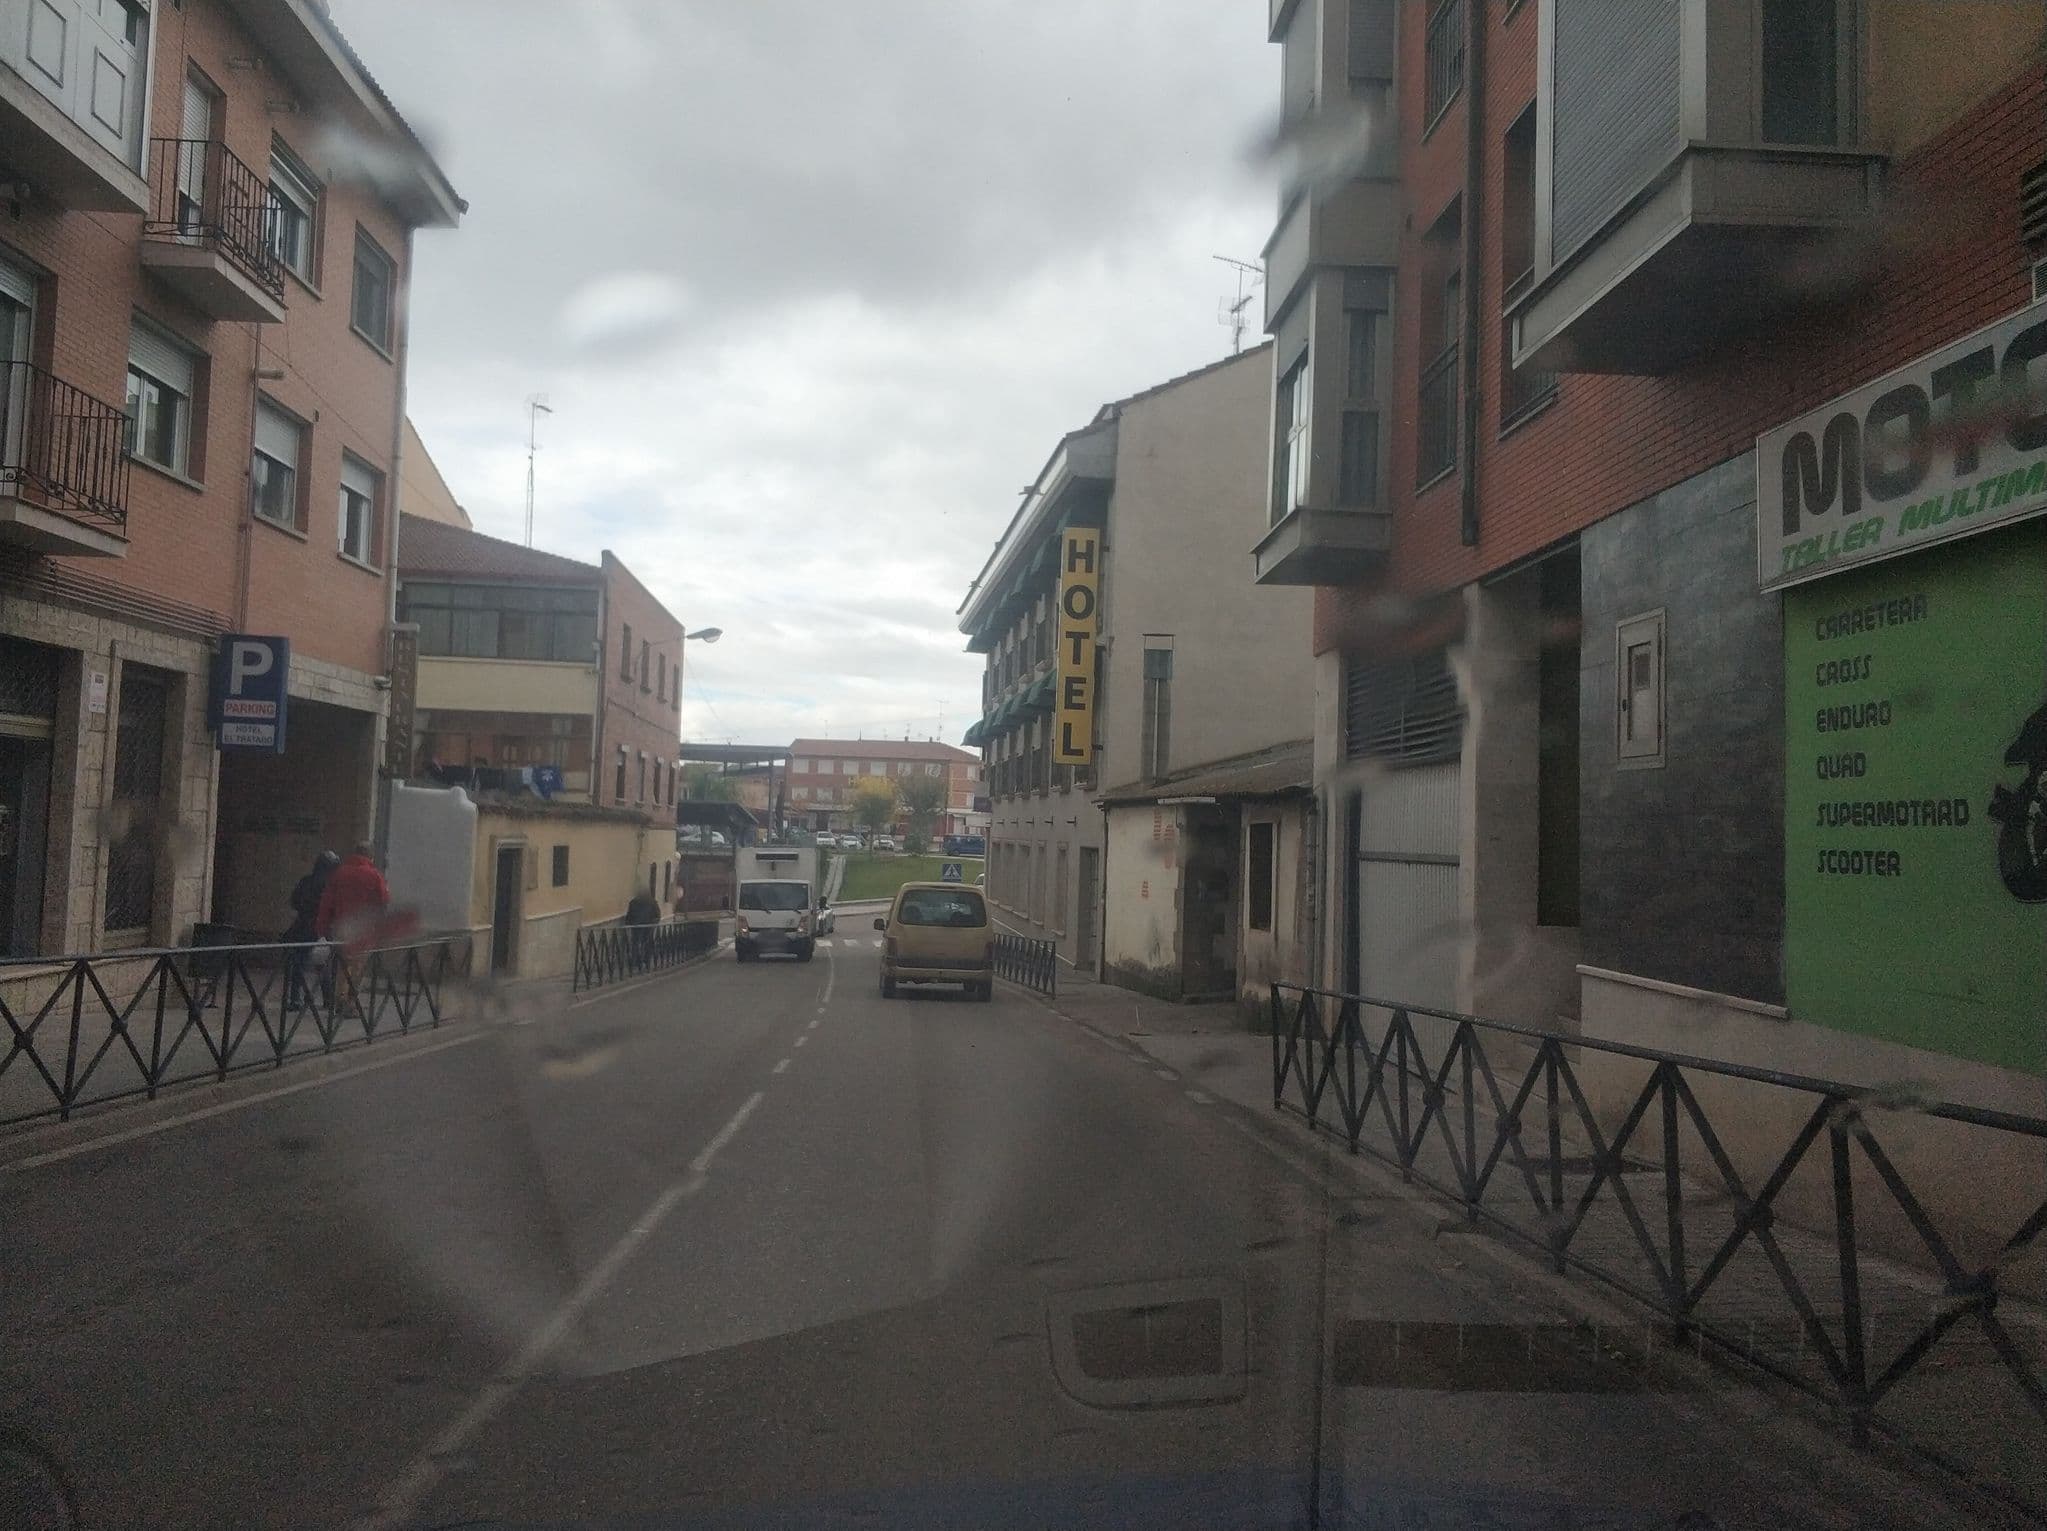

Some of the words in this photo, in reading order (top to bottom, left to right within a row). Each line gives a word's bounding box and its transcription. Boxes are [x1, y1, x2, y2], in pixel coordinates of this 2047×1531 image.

[1782, 516, 1885, 573] TALLER
[1815, 592, 1929, 641] CARRETERA
[1062, 539, 1095, 757] HOTEL
[230, 641, 274, 695] P
[1815, 654, 1872, 687] CROSS
[225, 702, 274, 715] PARKING
[1815, 700, 1892, 733] ENDURO
[1816, 752, 1866, 780] QUAD
[1816, 798, 1970, 827] SUPERMOTARD
[1817, 850, 1901, 876] SCOOTER
